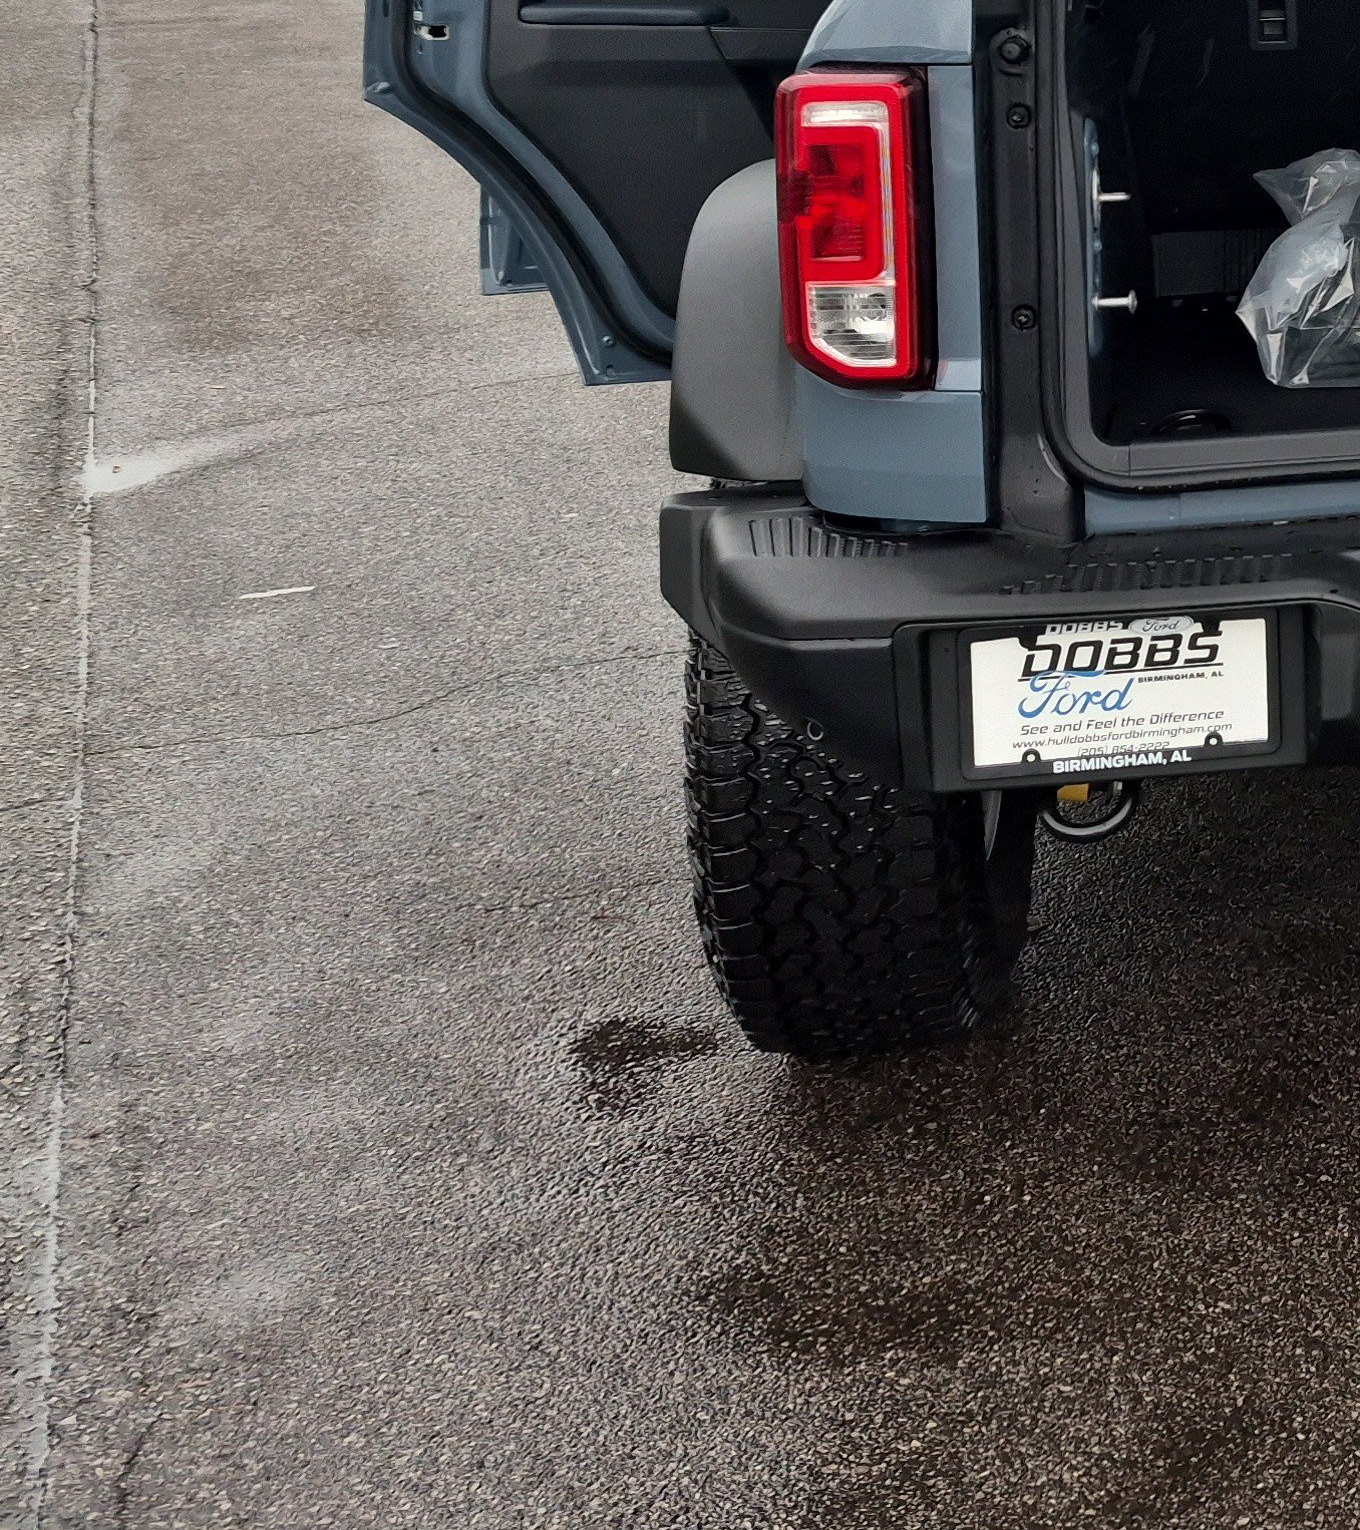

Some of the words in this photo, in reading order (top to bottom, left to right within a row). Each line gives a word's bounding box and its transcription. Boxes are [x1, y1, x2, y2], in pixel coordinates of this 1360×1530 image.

[1044, 620, 1123, 636] DOBBS
[1142, 617, 1180, 633] Ford
[1020, 631, 1223, 677] DOBBS
[1137, 671, 1208, 683] BIRMINGHAM,
[1018, 669, 1135, 719] Ford
[1012, 723, 1233, 749] www.hulldobbsfordbirmingham.com
[1020, 725, 1049, 736] See
[1053, 720, 1083, 733] and
[1086, 717, 1117, 730] Feel
[1121, 716, 1145, 727] the
[1149, 710, 1224, 725] Difference
[1052, 751, 1168, 774] BIRMINGHAM,
[1170, 749, 1193, 763] AL
